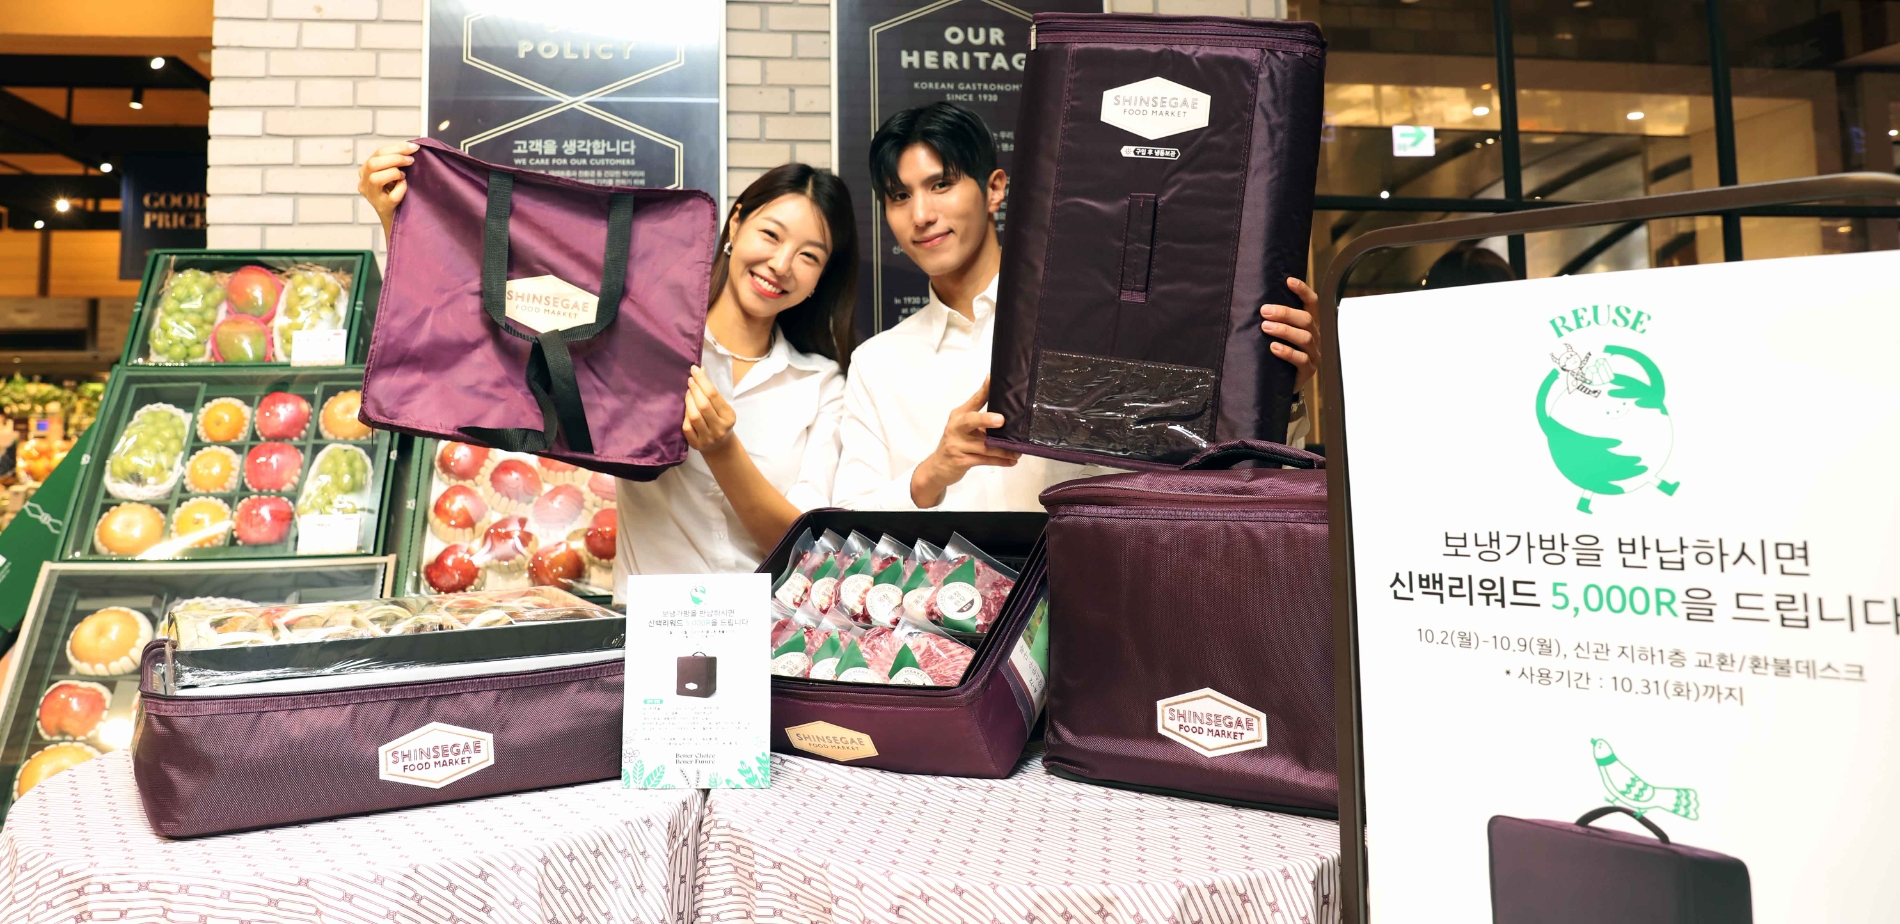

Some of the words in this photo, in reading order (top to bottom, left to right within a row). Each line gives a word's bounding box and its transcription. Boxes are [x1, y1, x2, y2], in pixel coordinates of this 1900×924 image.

[944, 26, 1006, 46] OUR
[517, 40, 636, 60] POLICY
[901, 50, 1026, 72] HERITAG
[914, 82, 954, 90] KOREAN
[958, 82, 1022, 92] GASTRONOM
[946, 94, 973, 102] SINCE
[978, 94, 998, 102] 1930
[1113, 94, 1198, 110] SHINSEGAE
[1123, 108, 1148, 116] FOOD
[1151, 110, 1187, 118] MARKET
[513, 139, 558, 155] 고객을
[562, 139, 636, 155] 생각합니다
[513, 158, 527, 166] WE
[528, 158, 549, 166] CARE
[551, 158, 568, 166] FOR
[569, 158, 587, 166] OUR
[589, 158, 635, 166] CUSTOMERS
[143, 192, 207, 210] GOOD
[143, 212, 207, 229] PRICE
[506, 290, 589, 312] SHINSEGAE
[515, 304, 541, 314] FOOD
[543, 308, 579, 319] MARKET
[1548, 304, 1652, 338] REUSE
[1443, 530, 1604, 568] 보냉가방을
[1618, 535, 1811, 577] 반납하시면
[1389, 570, 1541, 609] 신백리워드
[1551, 581, 1717, 623] 5,000R을
[1732, 592, 1900, 636] 드립니다
[662, 609, 697, 618] 보냉가방을
[648, 619, 683, 627] 신백리워드
[720, 618, 749, 627] 드립니다
[1573, 641, 1611, 661] 신관
[1617, 645, 1687, 668] 지하1층
[1694, 651, 1867, 682] 교환/환불데스크
[1518, 666, 1592, 691] 사용기간
[1611, 675, 1745, 706] 10.31(화)까지
[1168, 707, 1255, 732] SHINSEGAE
[795, 732, 865, 746] SHINSEGAE
[1178, 724, 1204, 735] FOOD
[1206, 728, 1245, 741] MARKET
[391, 740, 482, 765] SHINSEGAE
[831, 744, 860, 752] MARKET
[403, 761, 431, 773] FOOD
[434, 756, 472, 769] MARKET
